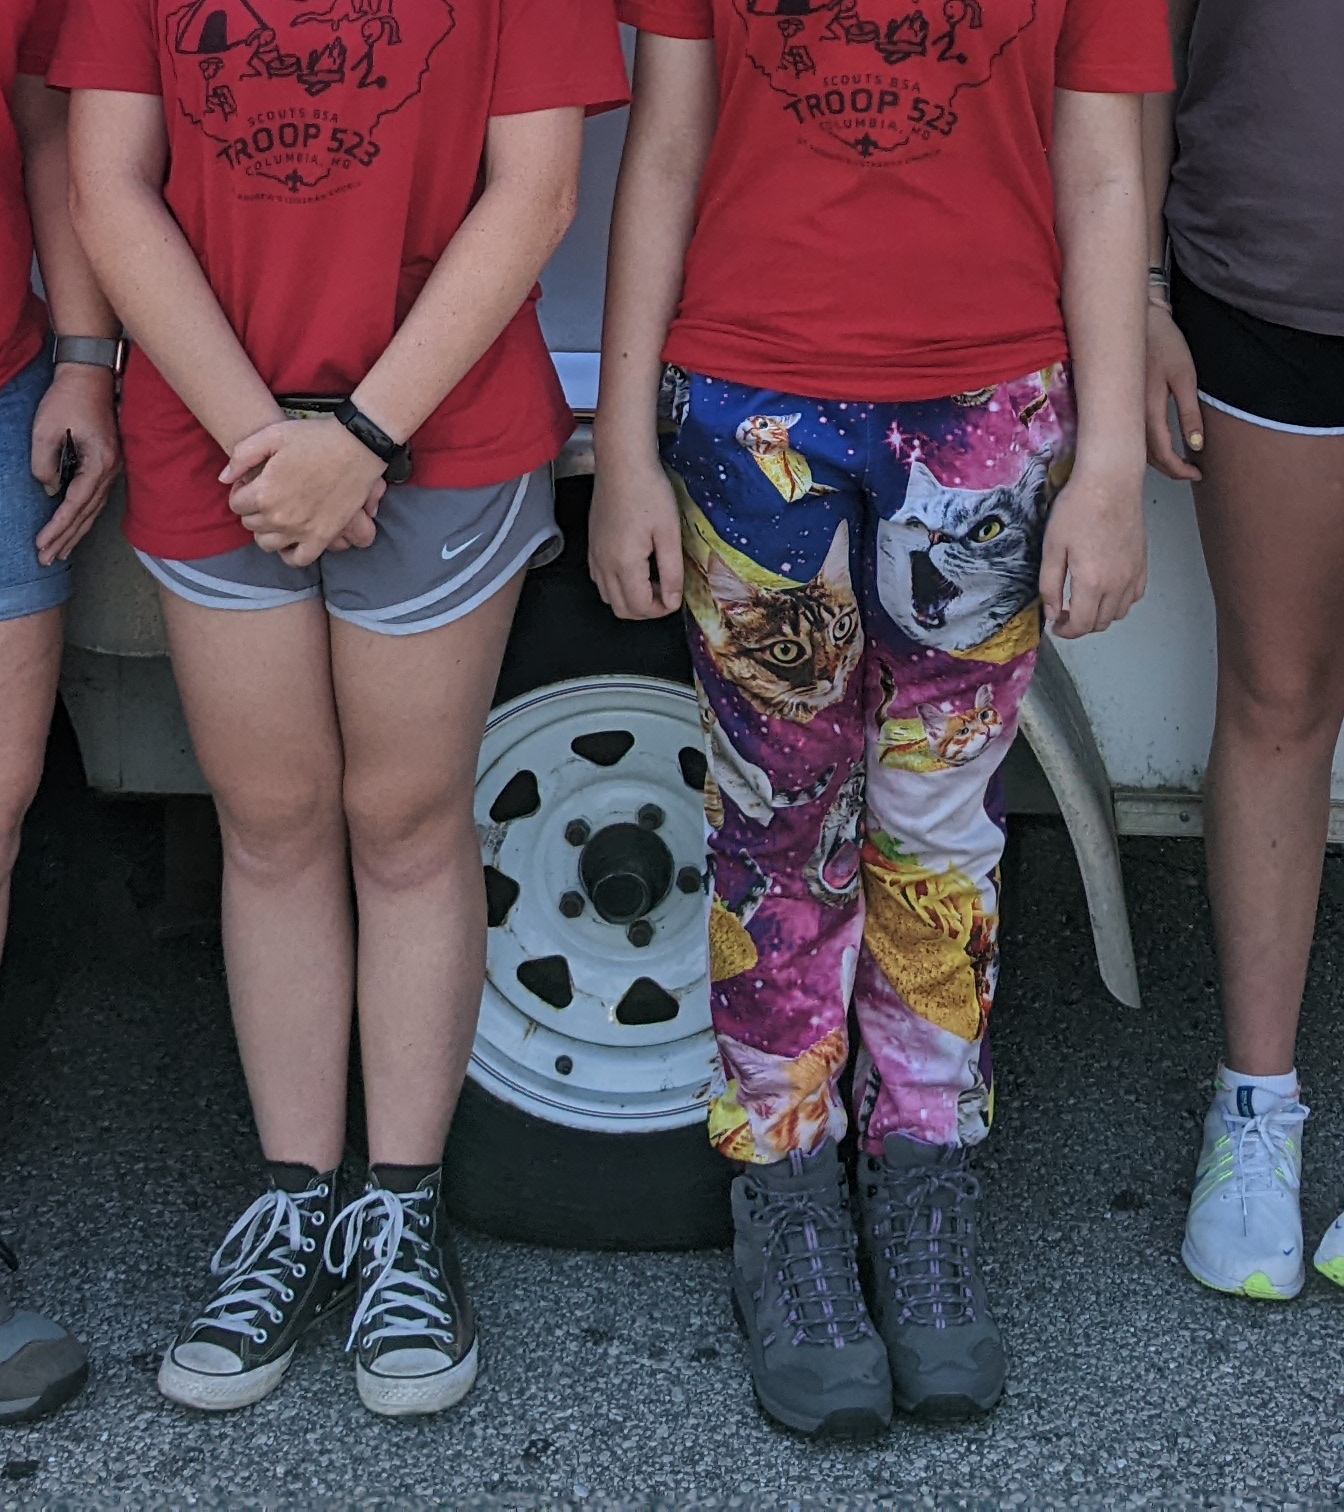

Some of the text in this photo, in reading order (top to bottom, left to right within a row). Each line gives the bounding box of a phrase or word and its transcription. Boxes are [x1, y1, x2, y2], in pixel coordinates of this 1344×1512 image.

[823, 73, 883, 88] SCOUTS
[247, 107, 306, 128] SCOUTS
[783, 88, 959, 137] TROOP 523
[216, 122, 381, 171] TROOP 523
